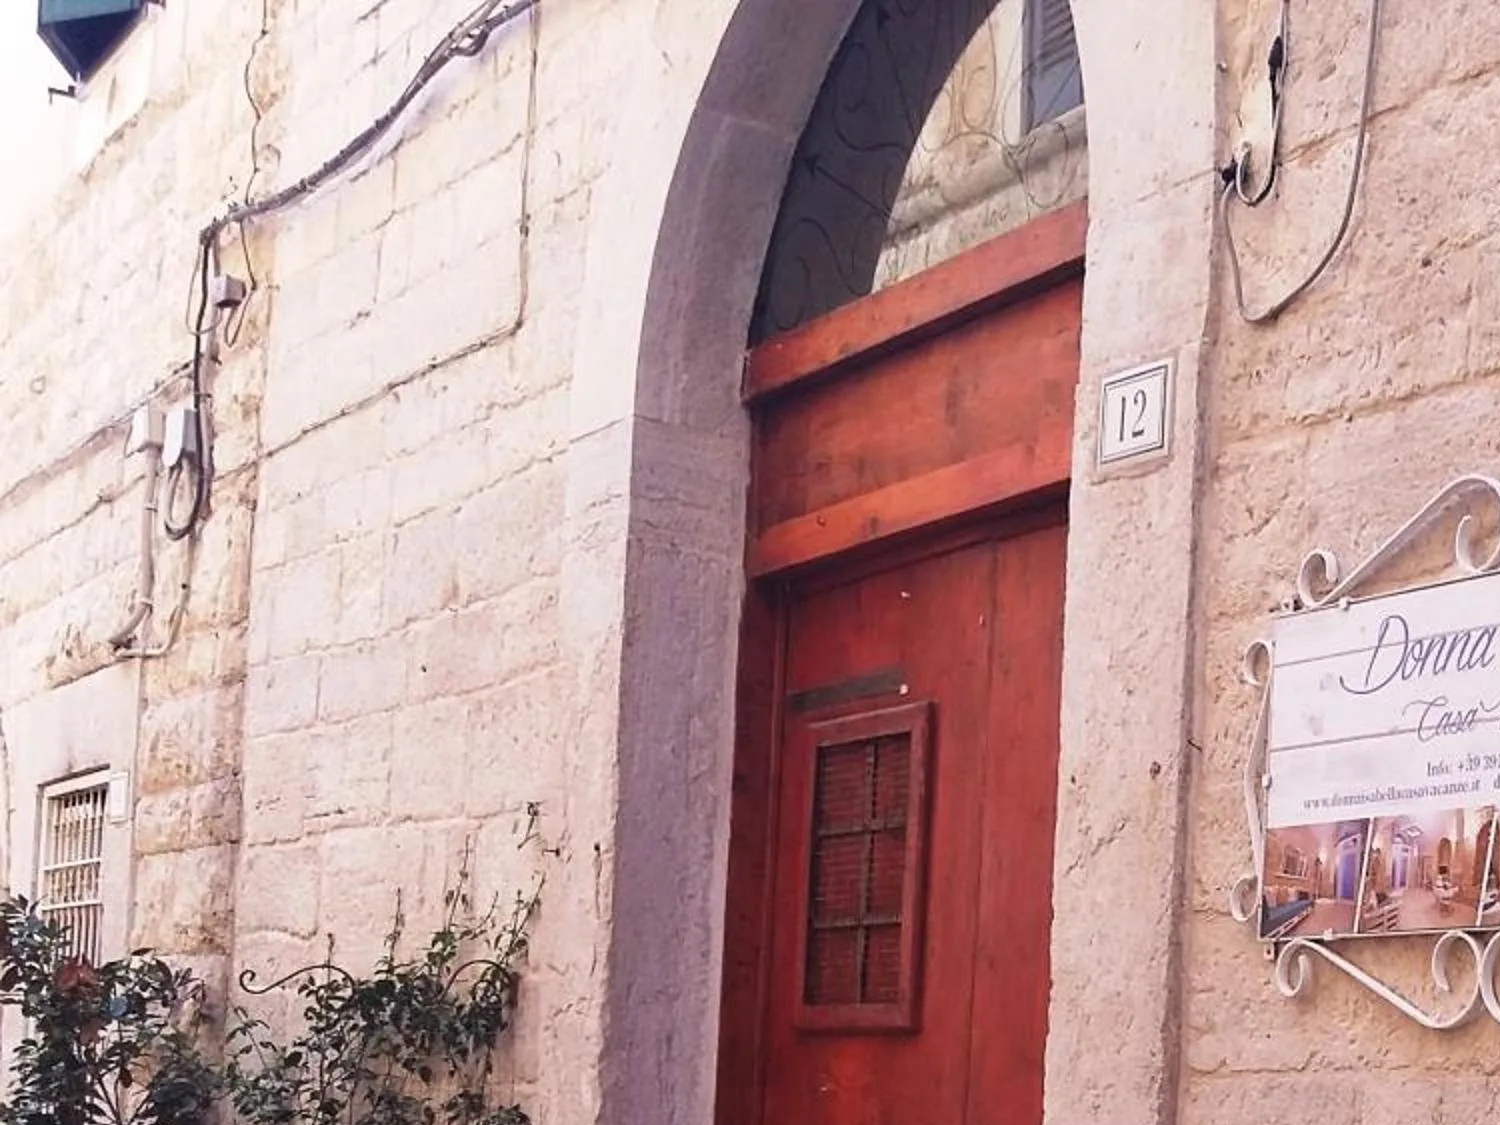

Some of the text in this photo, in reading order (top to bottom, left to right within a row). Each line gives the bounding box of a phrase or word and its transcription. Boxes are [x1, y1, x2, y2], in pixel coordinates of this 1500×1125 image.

[1119, 388, 1147, 443] 12
[1339, 614, 1496, 695] Donna
[1402, 696, 1480, 743] Casa
